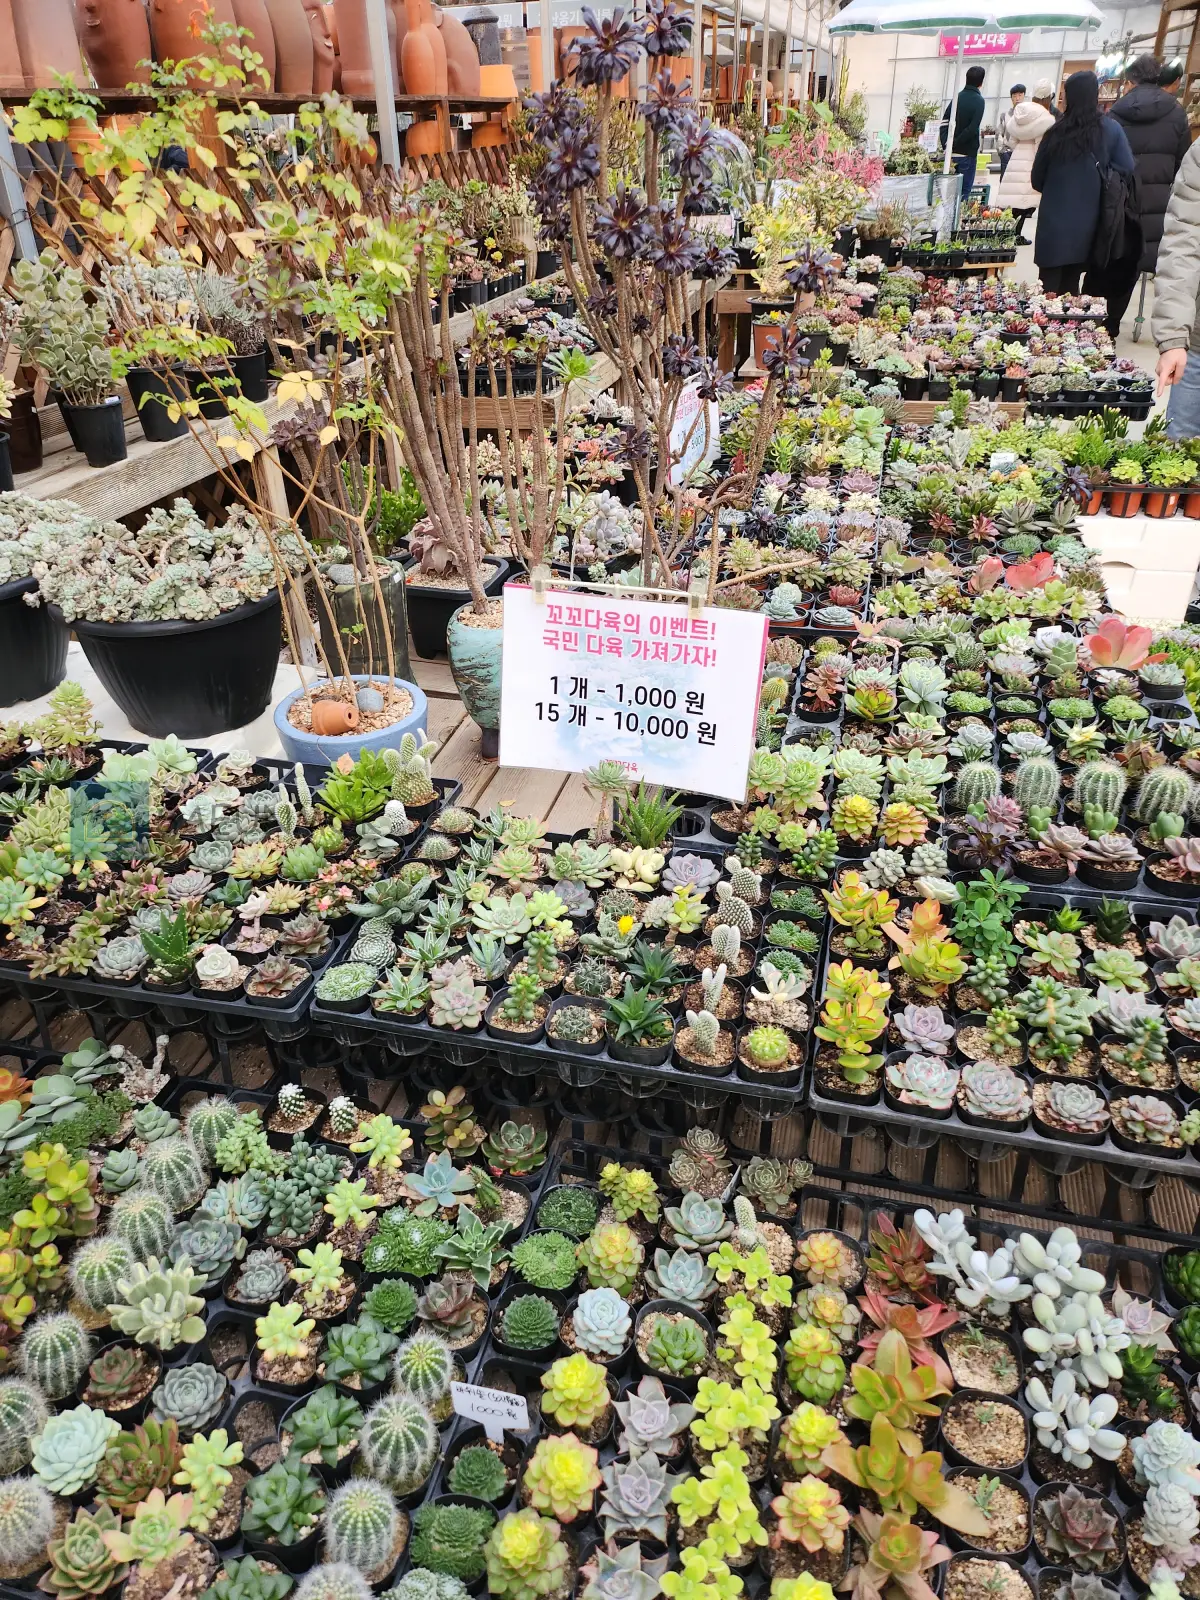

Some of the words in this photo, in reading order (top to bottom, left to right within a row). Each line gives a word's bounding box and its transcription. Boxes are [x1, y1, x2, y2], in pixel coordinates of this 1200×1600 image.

[545, 605, 641, 634] 꼬꼬다육의
[649, 616, 717, 640] 이벤트!
[542, 630, 579, 652] 국민
[586, 635, 623, 658] 다육
[631, 640, 717, 667] 가져가자!
[549, 676, 560, 694] 1
[568, 677, 589, 699] 개
[614, 684, 677, 709] 1,000
[684, 692, 706, 715] 원
[534, 703, 561, 721] 15
[568, 705, 587, 726] 개
[613, 712, 689, 739] 10,000
[696, 722, 718, 746] 원
